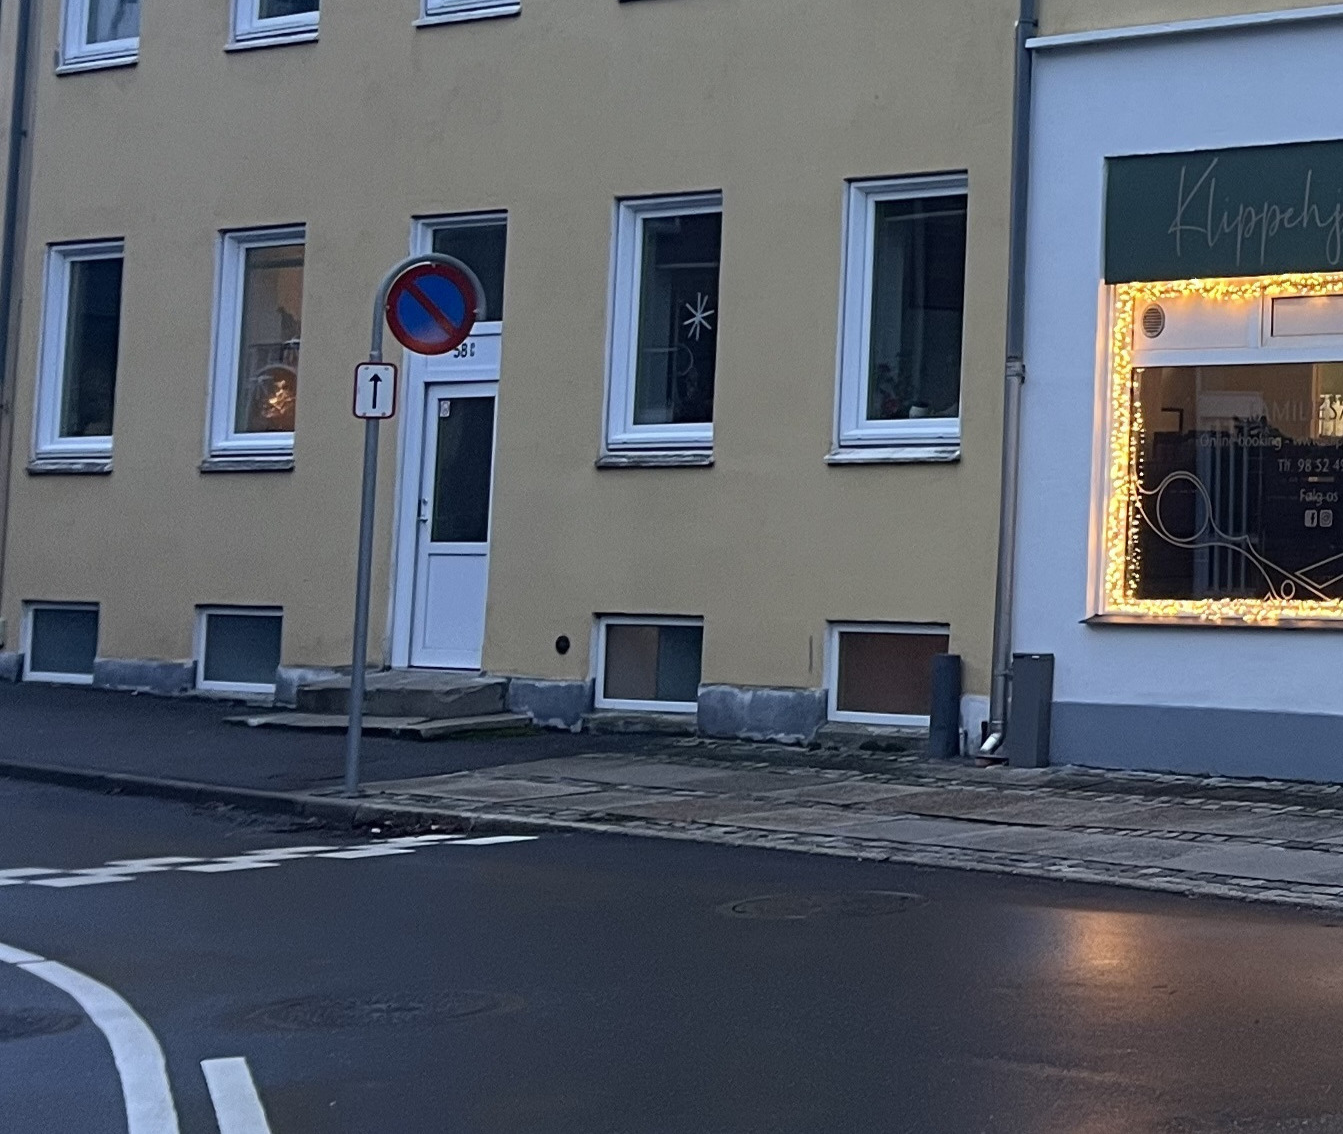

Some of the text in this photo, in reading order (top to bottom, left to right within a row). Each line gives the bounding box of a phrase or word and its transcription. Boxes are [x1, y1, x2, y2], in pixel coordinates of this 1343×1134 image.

[1297, 458, 1312, 473] 98
[1315, 458, 1330, 473] 52
[1326, 492, 1338, 502] os
